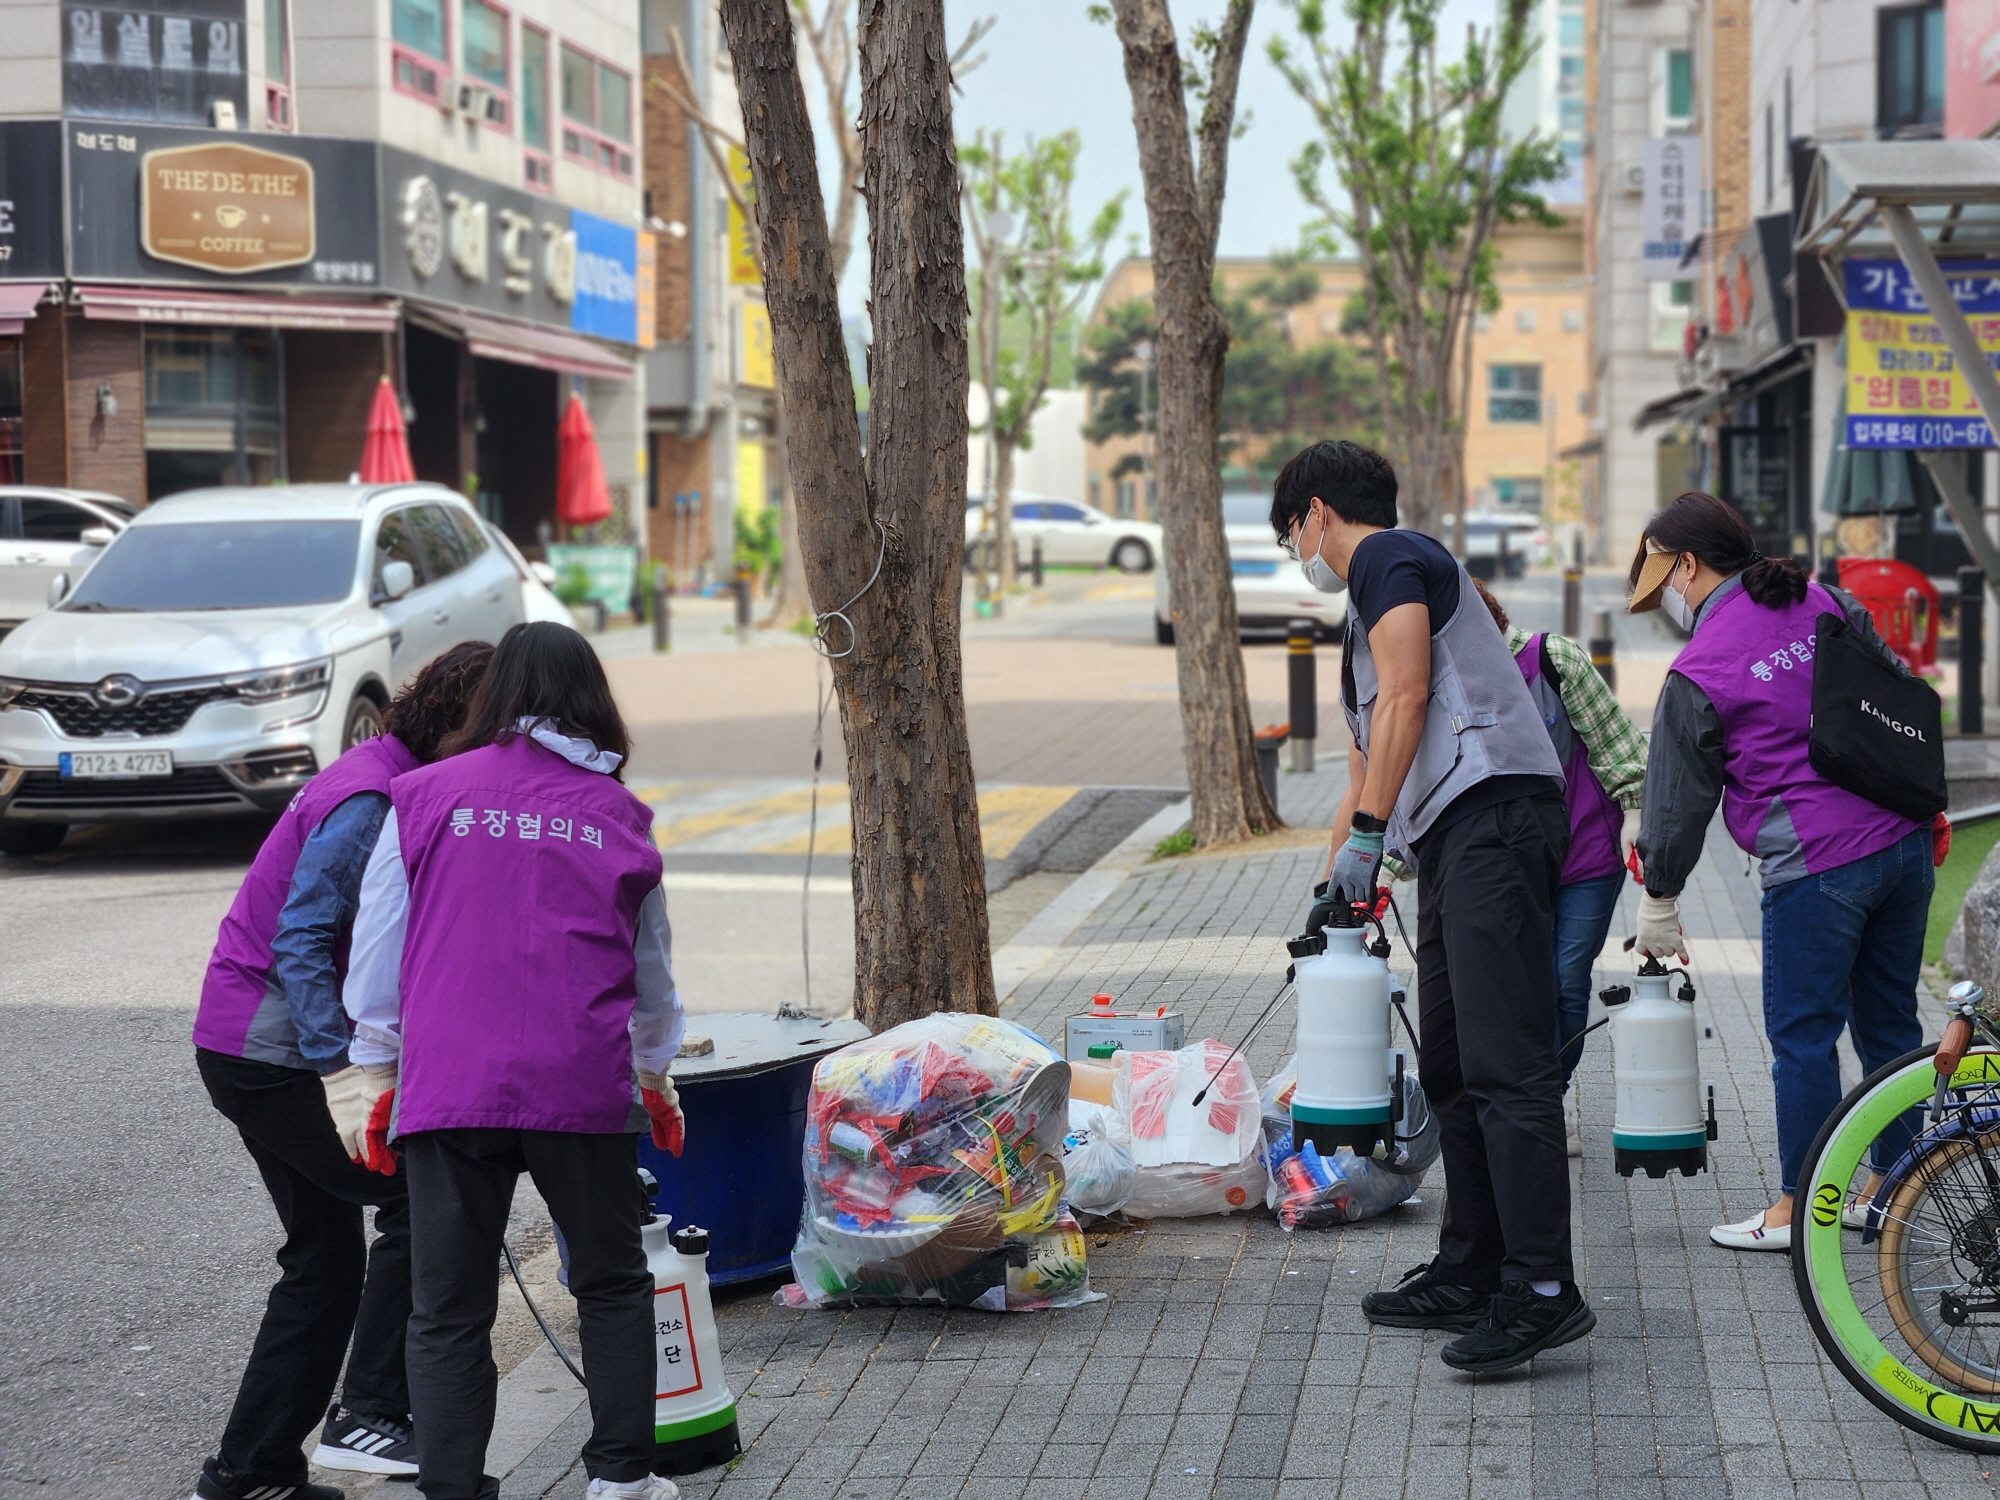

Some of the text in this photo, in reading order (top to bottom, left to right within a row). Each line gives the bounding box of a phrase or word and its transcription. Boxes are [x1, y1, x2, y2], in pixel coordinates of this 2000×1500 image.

[212, 171, 246, 194] DE
[199, 236, 265, 254] COFFEE
[1853, 421, 1918, 445] 입주문의
[1860, 699, 1927, 743] KANGOL
[123, 753, 167, 772] 4273
[449, 807, 603, 850] 통장협의회
[664, 1344, 682, 1364] 단
[1892, 1368, 1932, 1399] MASTER
